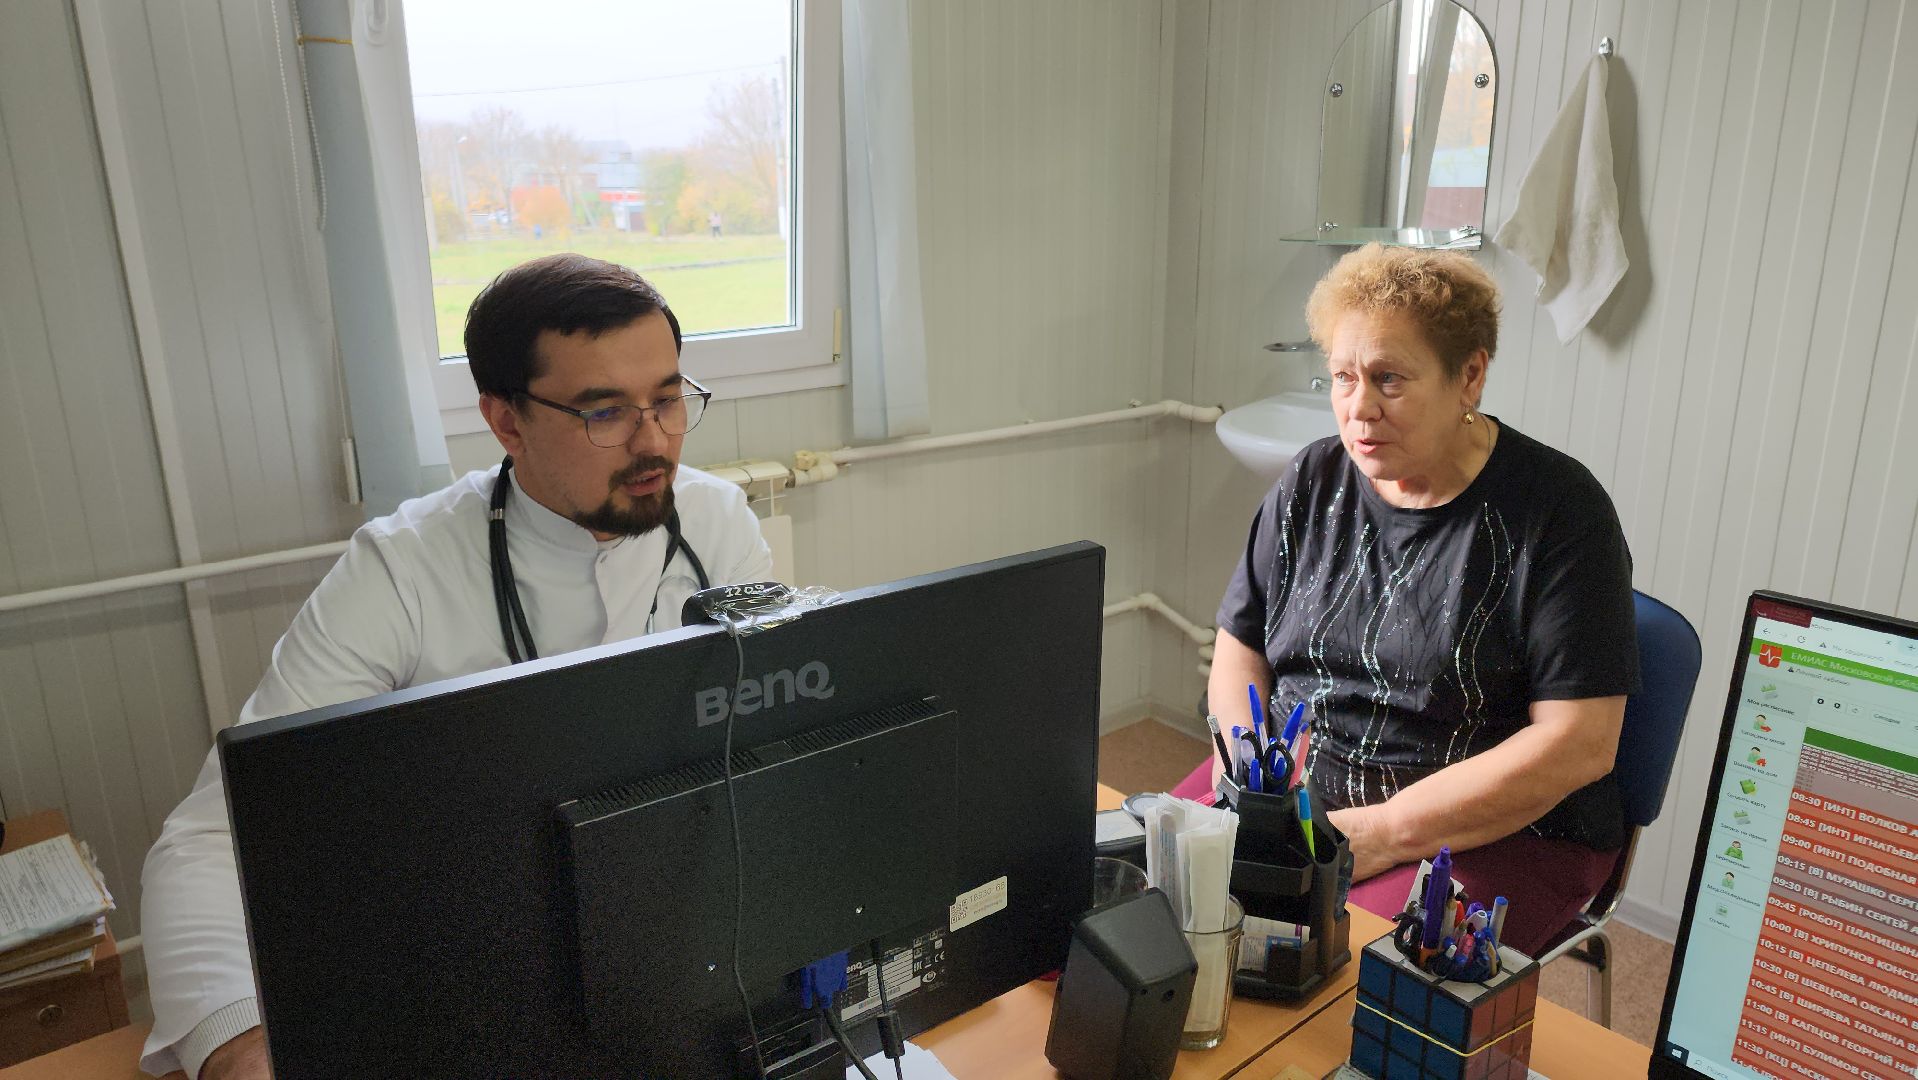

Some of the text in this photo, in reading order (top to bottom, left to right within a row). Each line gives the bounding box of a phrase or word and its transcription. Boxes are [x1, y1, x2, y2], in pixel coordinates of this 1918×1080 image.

[1791, 652, 1828, 668] ЕМИАС
[1829, 659, 1894, 684] Московской
[695, 660, 835, 727] BenQ
[1787, 812, 1816, 828] 08:45
[1818, 822, 1851, 840] [ИНТ]
[1791, 791, 1821, 807] 08:30
[1824, 801, 1857, 819] [ИНТ]
[1858, 812, 1908, 834] ВОЛКОВ
[1777, 855, 1806, 871] 09:15
[1826, 872, 1887, 898] МУРАШКО
[1782, 834, 1917, 885] 09:00 [ИНТ] ПОДОБНАЯ
[1768, 896, 1796, 913] 09:45
[1798, 907, 1844, 931] [РОБОТ]
[1772, 876, 1801, 892] 09:30
[1821, 893, 1864, 915] РЫБИН
[1865, 909, 1909, 930] СЕРГЕЙ
[1759, 938, 1787, 954] 10:15
[1806, 956, 1865, 986] ЦЕПЕЛЕВА
[1764, 917, 1792, 933] 10:00
[1810, 935, 1875, 965] ХРИПУНОВ
[847, 961, 864, 974] enQ
[1750, 978, 1777, 995] 10:45
[1796, 996, 1851, 1026] ШИРЯЕВА
[1853, 1020, 1905, 1047] ТАТЬЯНА
[1755, 958, 1782, 975] 10:30
[1801, 977, 1858, 1006] ШЕВЦОВА
[1860, 1001, 1909, 1026] ОКСАНА
[1737, 1038, 1764, 1055] 11:30
[1741, 1018, 1767, 1035] 11:15
[1769, 1030, 1801, 1051] [ИНТ]
[1802, 1044, 1859, 1075] БУЛИМОВ
[1746, 998, 1773, 1015] 11:00
[1791, 1017, 1840, 1044] КАПЦОВ
[1841, 1038, 1893, 1067] ГЕОРГИЙ
